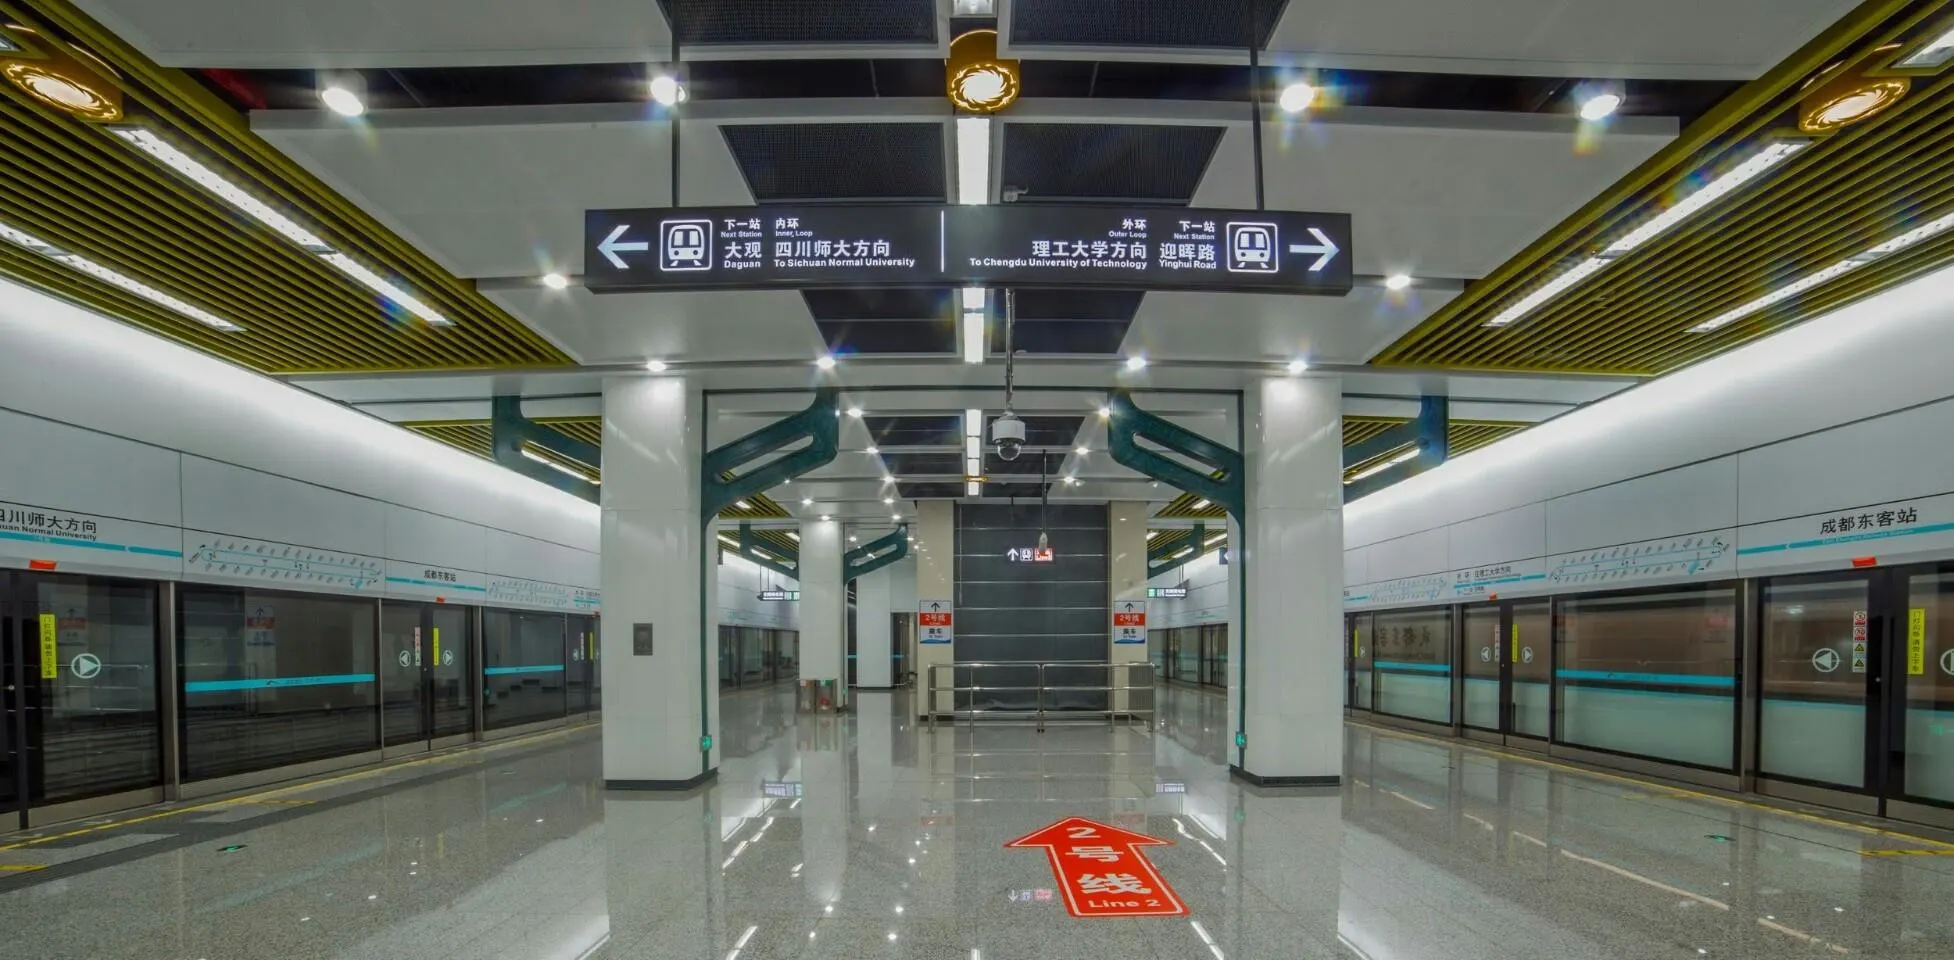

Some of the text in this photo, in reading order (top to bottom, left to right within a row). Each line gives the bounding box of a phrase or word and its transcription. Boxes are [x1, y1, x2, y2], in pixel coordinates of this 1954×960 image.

[723, 218, 761, 231] 下一站
[775, 217, 799, 230] 内环
[1122, 219, 1147, 231] 外环
[1179, 220, 1215, 233] 下一站
[738, 230, 763, 238] Station
[1108, 230, 1147, 239] Outer Loop
[1173, 232, 1215, 241] Next Station
[724, 240, 762, 259] 大观
[775, 239, 890, 258] 四川师大方向
[1031, 240, 1147, 258] 理工大学方向
[1160, 242, 1216, 261] 迎晖路
[723, 260, 761, 270] Daguan
[774, 257, 916, 268] To Sichuan Normal University
[969, 257, 1148, 270] To Chengdu University of Technology
[1158, 259, 1217, 270] Yinghui Road
[1820, 506, 1918, 535] 成都东客站
[22, 526, 54, 536] Normal
[55, 530, 97, 542] University
[1087, 900, 1139, 908] Line
